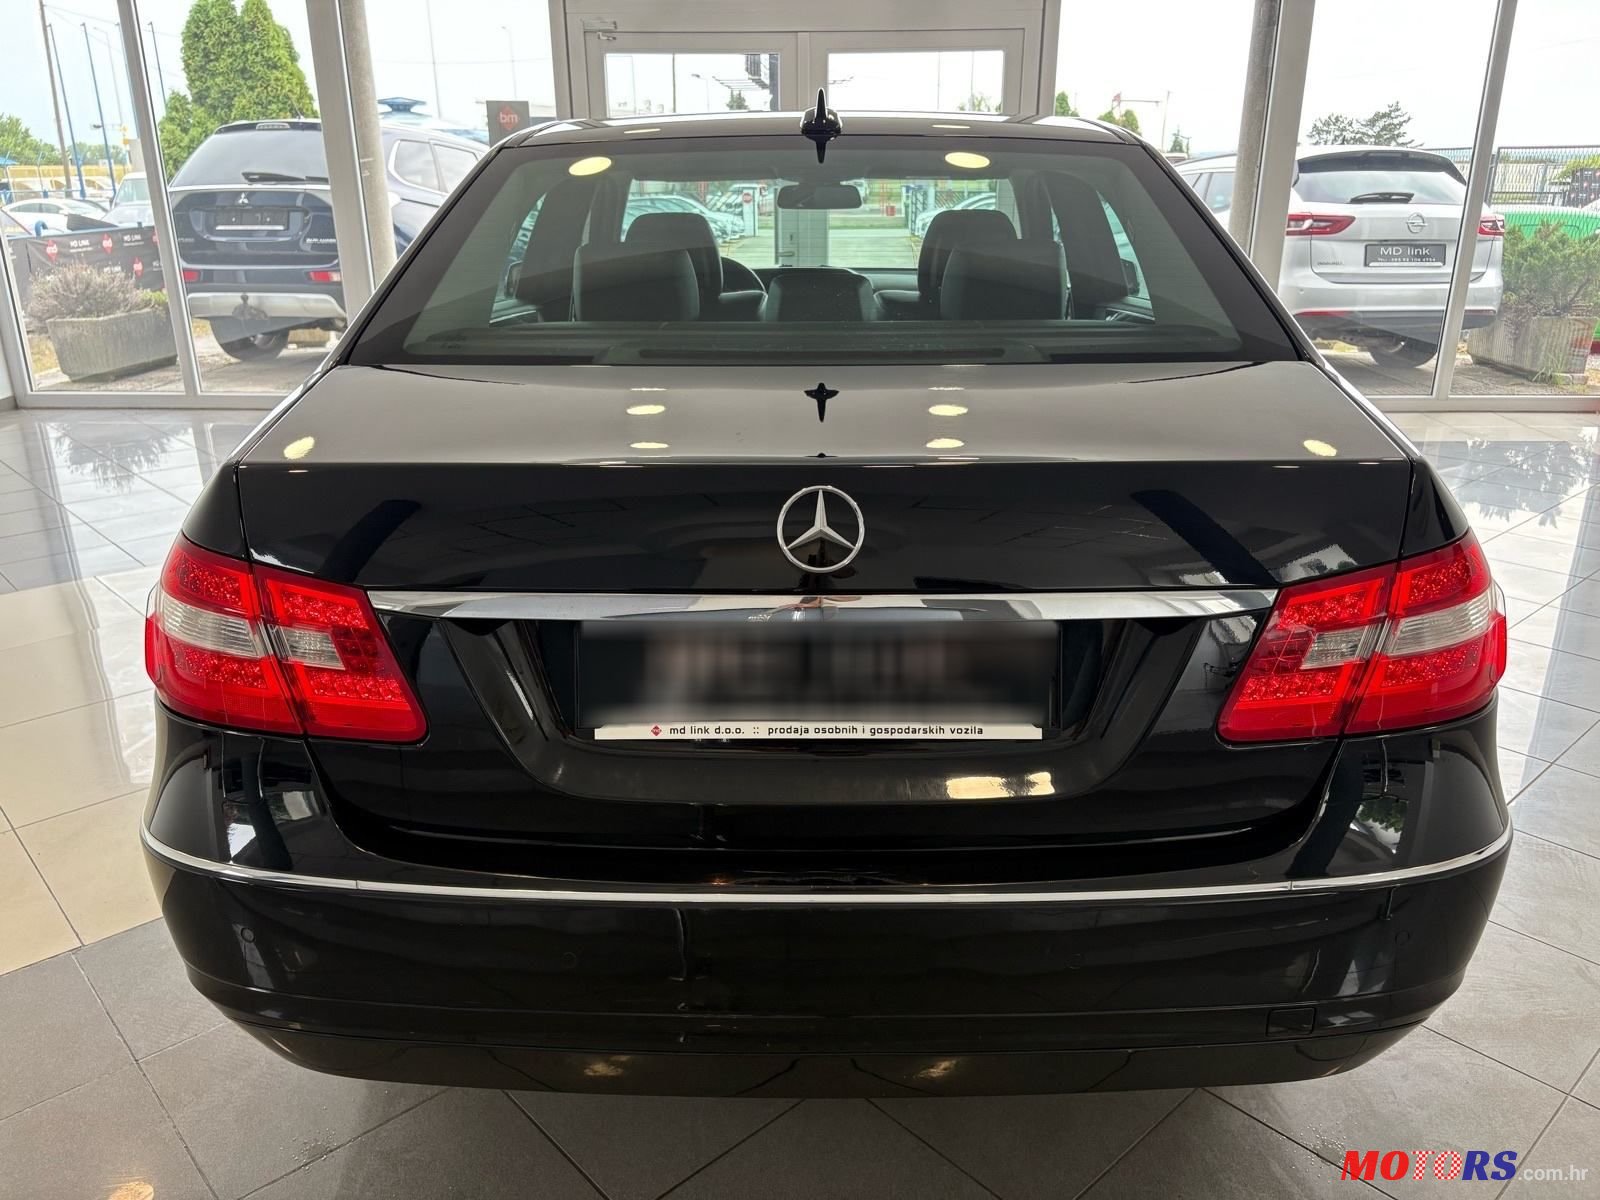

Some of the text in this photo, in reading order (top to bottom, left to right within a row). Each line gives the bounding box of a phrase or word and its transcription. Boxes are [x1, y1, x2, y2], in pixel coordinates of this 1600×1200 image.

[1380, 246, 1430, 256] MD link
[669, 725, 686, 735] md
[690, 725, 710, 735] link
[714, 725, 745, 735] d.o.o.
[768, 725, 810, 736] prodaja
[814, 725, 858, 735] osobnih
[862, 725, 866, 735] i
[869, 725, 945, 737] gospodarskih
[949, 725, 984, 735] vozila
